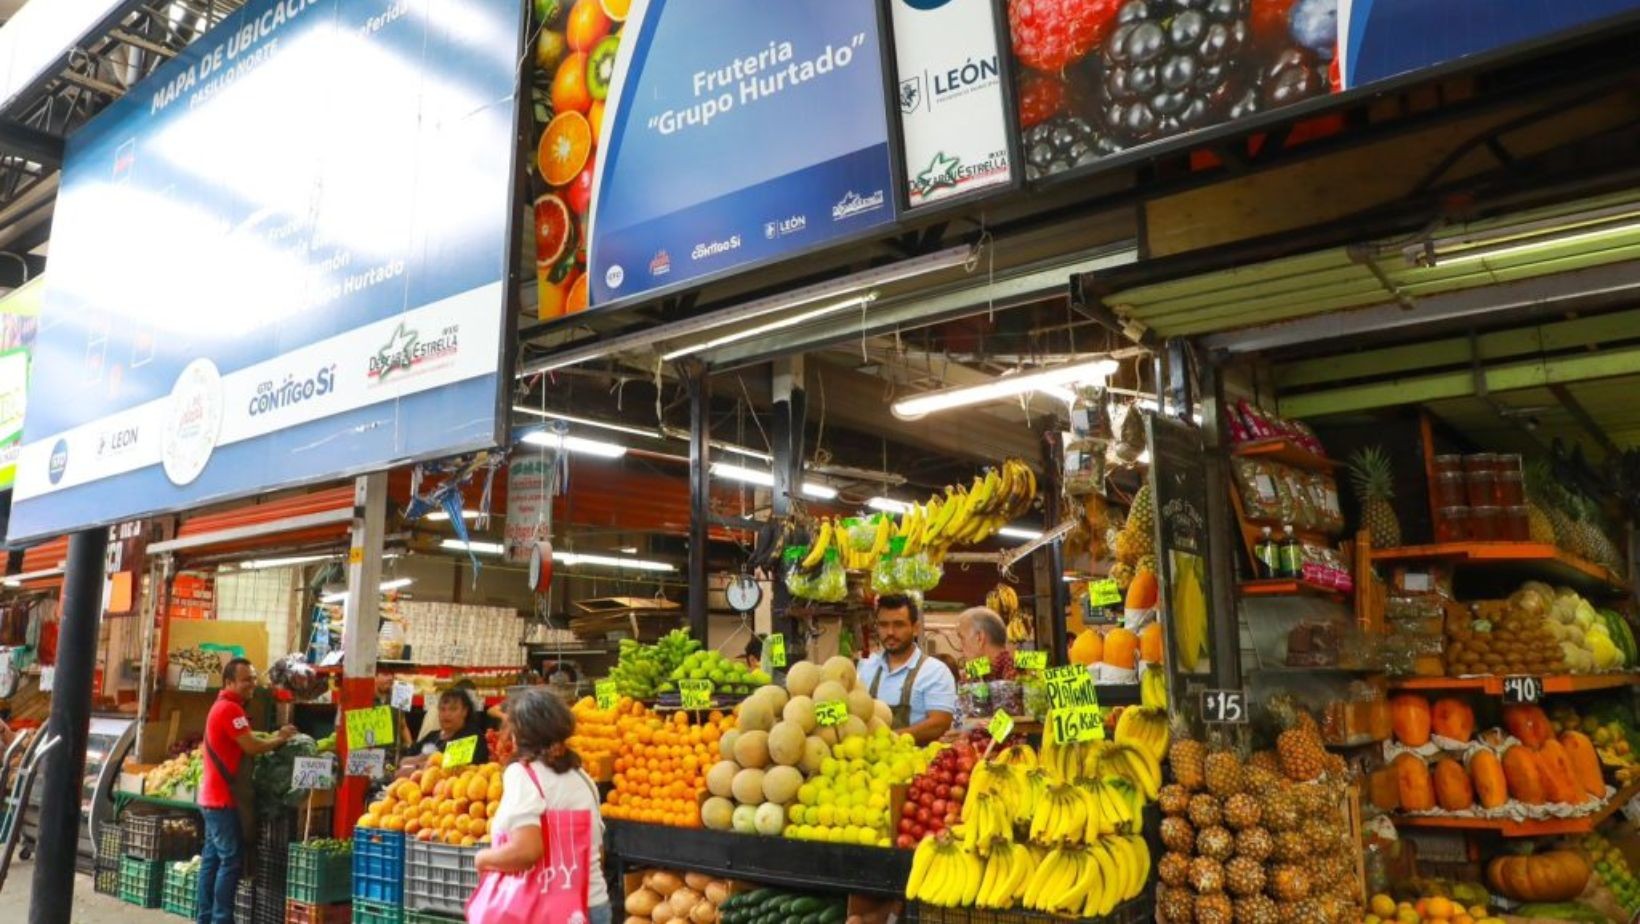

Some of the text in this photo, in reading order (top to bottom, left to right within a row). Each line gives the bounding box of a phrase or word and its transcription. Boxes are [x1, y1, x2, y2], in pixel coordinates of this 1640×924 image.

[151, 64, 196, 114] MAPA
[200, 47, 222, 81] DE
[693, 40, 792, 97] Fruteria
[934, 56, 998, 95] LEÓN
[344, 258, 405, 296] Hurtado
[1207, 691, 1241, 721] $15
[1053, 711, 1079, 743] 16
